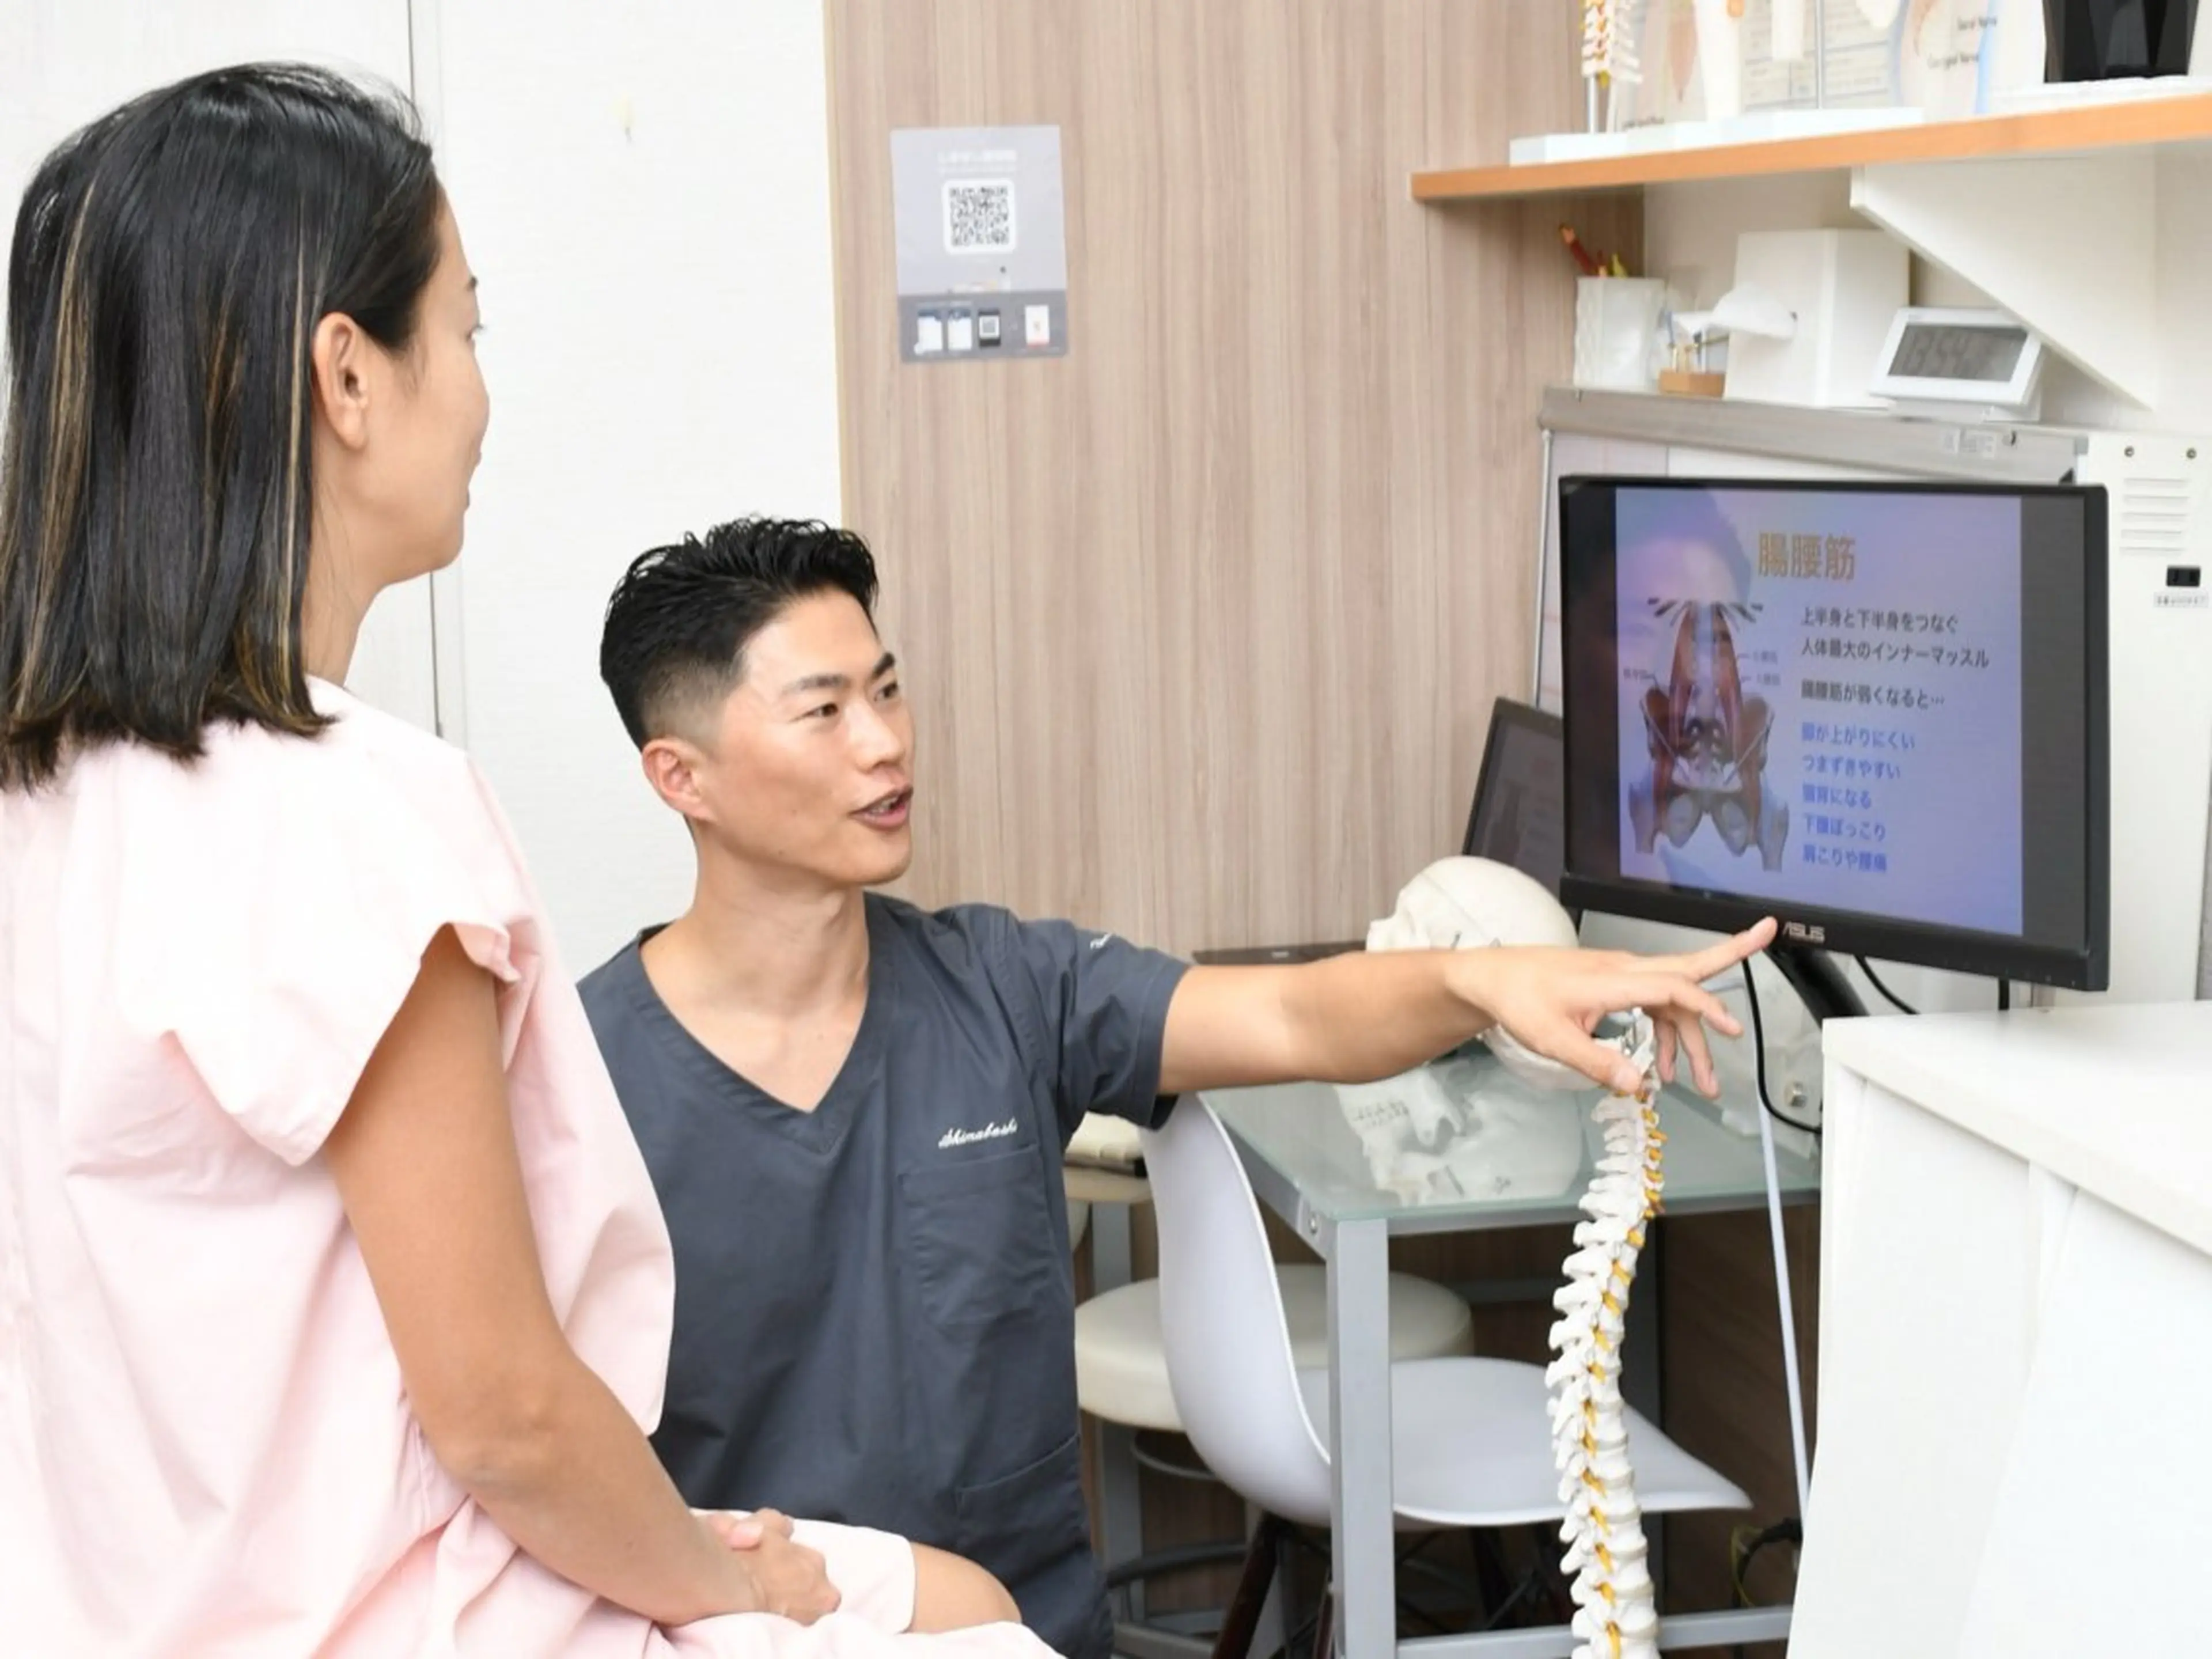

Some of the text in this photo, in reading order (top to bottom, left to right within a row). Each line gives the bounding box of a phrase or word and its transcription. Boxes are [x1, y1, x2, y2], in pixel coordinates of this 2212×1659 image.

[1758, 532, 1856, 581] 腸腰筋
[1801, 607, 1959, 634] 上半身と下半身をつなぐ
[1801, 637, 1990, 669] 人体最大のインナーマッスル
[1802, 753, 1902, 779] つまずきやすい
[1782, 921, 1825, 944] ASUS
